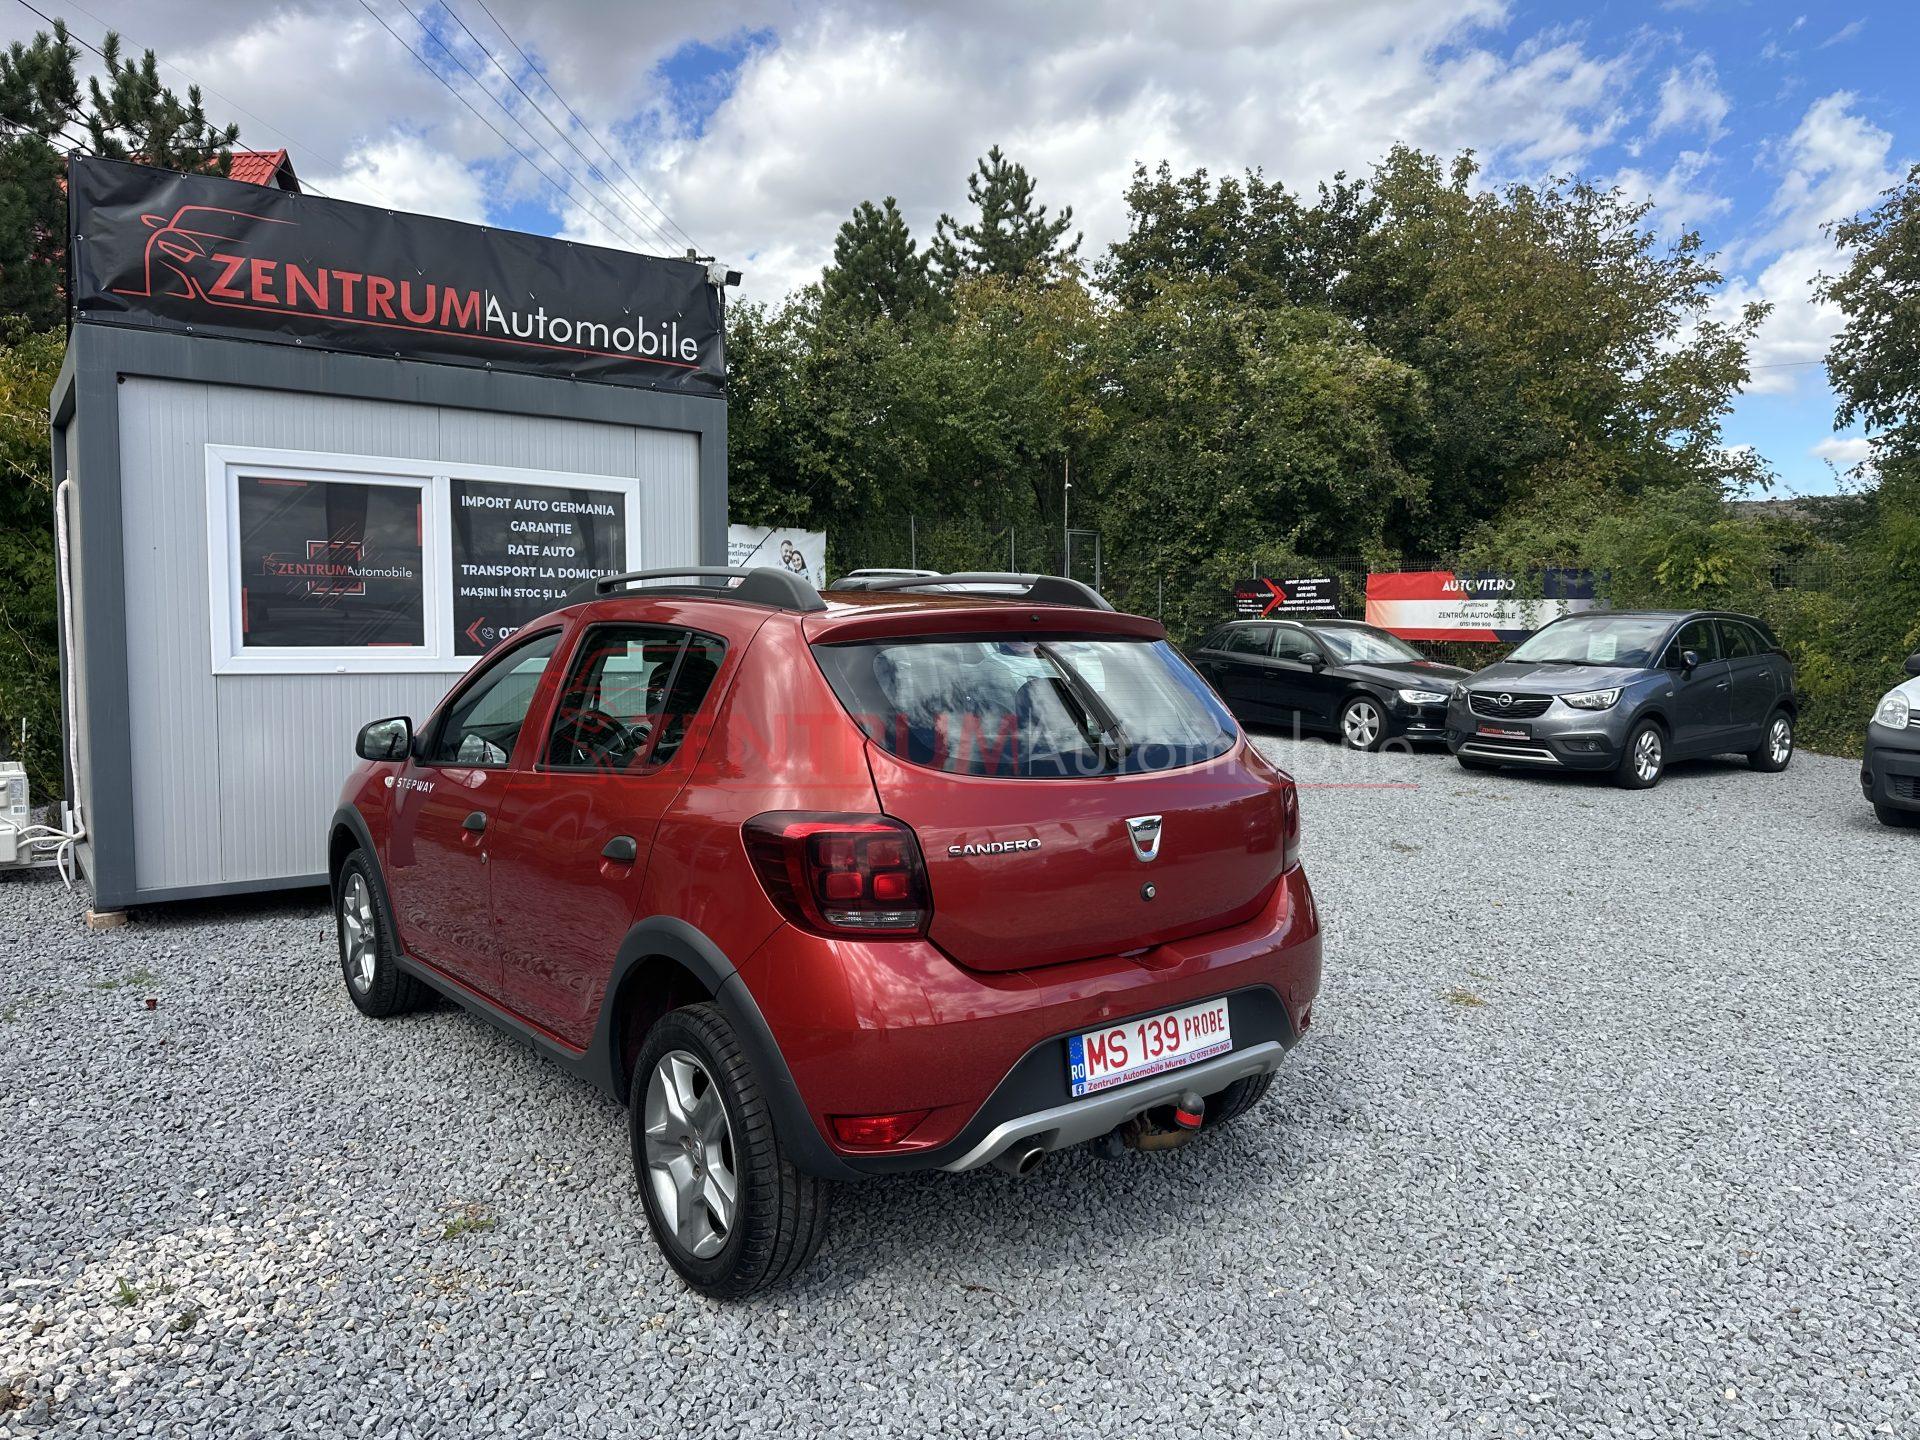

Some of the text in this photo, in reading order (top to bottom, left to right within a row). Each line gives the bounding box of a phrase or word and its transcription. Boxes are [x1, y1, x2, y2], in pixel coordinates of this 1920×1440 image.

[208, 253, 698, 361] ZENTRUM Automobile
[461, 495, 615, 516] IMPORT AUTO GERMANIA
[510, 520, 572, 536] GARANȚIE
[507, 544, 575, 558] RATE AUTO
[278, 563, 413, 578] ZENTRUM Automobile
[461, 564, 536, 578] TRANSPORT
[539, 567, 555, 578] LA
[460, 586, 567, 600] MAȘINI ÎN STOC ȘI LA
[1442, 578, 1516, 592] AUTOVIT.RO
[1438, 611, 1469, 619] ZENTRUM
[397, 777, 435, 793] STEPWAY
[948, 838, 1042, 858] SANDERO
[1086, 1008, 1225, 1076] MS 139 PROBE
[1071, 1064, 1085, 1081] RO
[1088, 1075, 1122, 1091] Zentrum
[1122, 1062, 1164, 1081] Automobile
[1164, 1056, 1187, 1070] Mures
